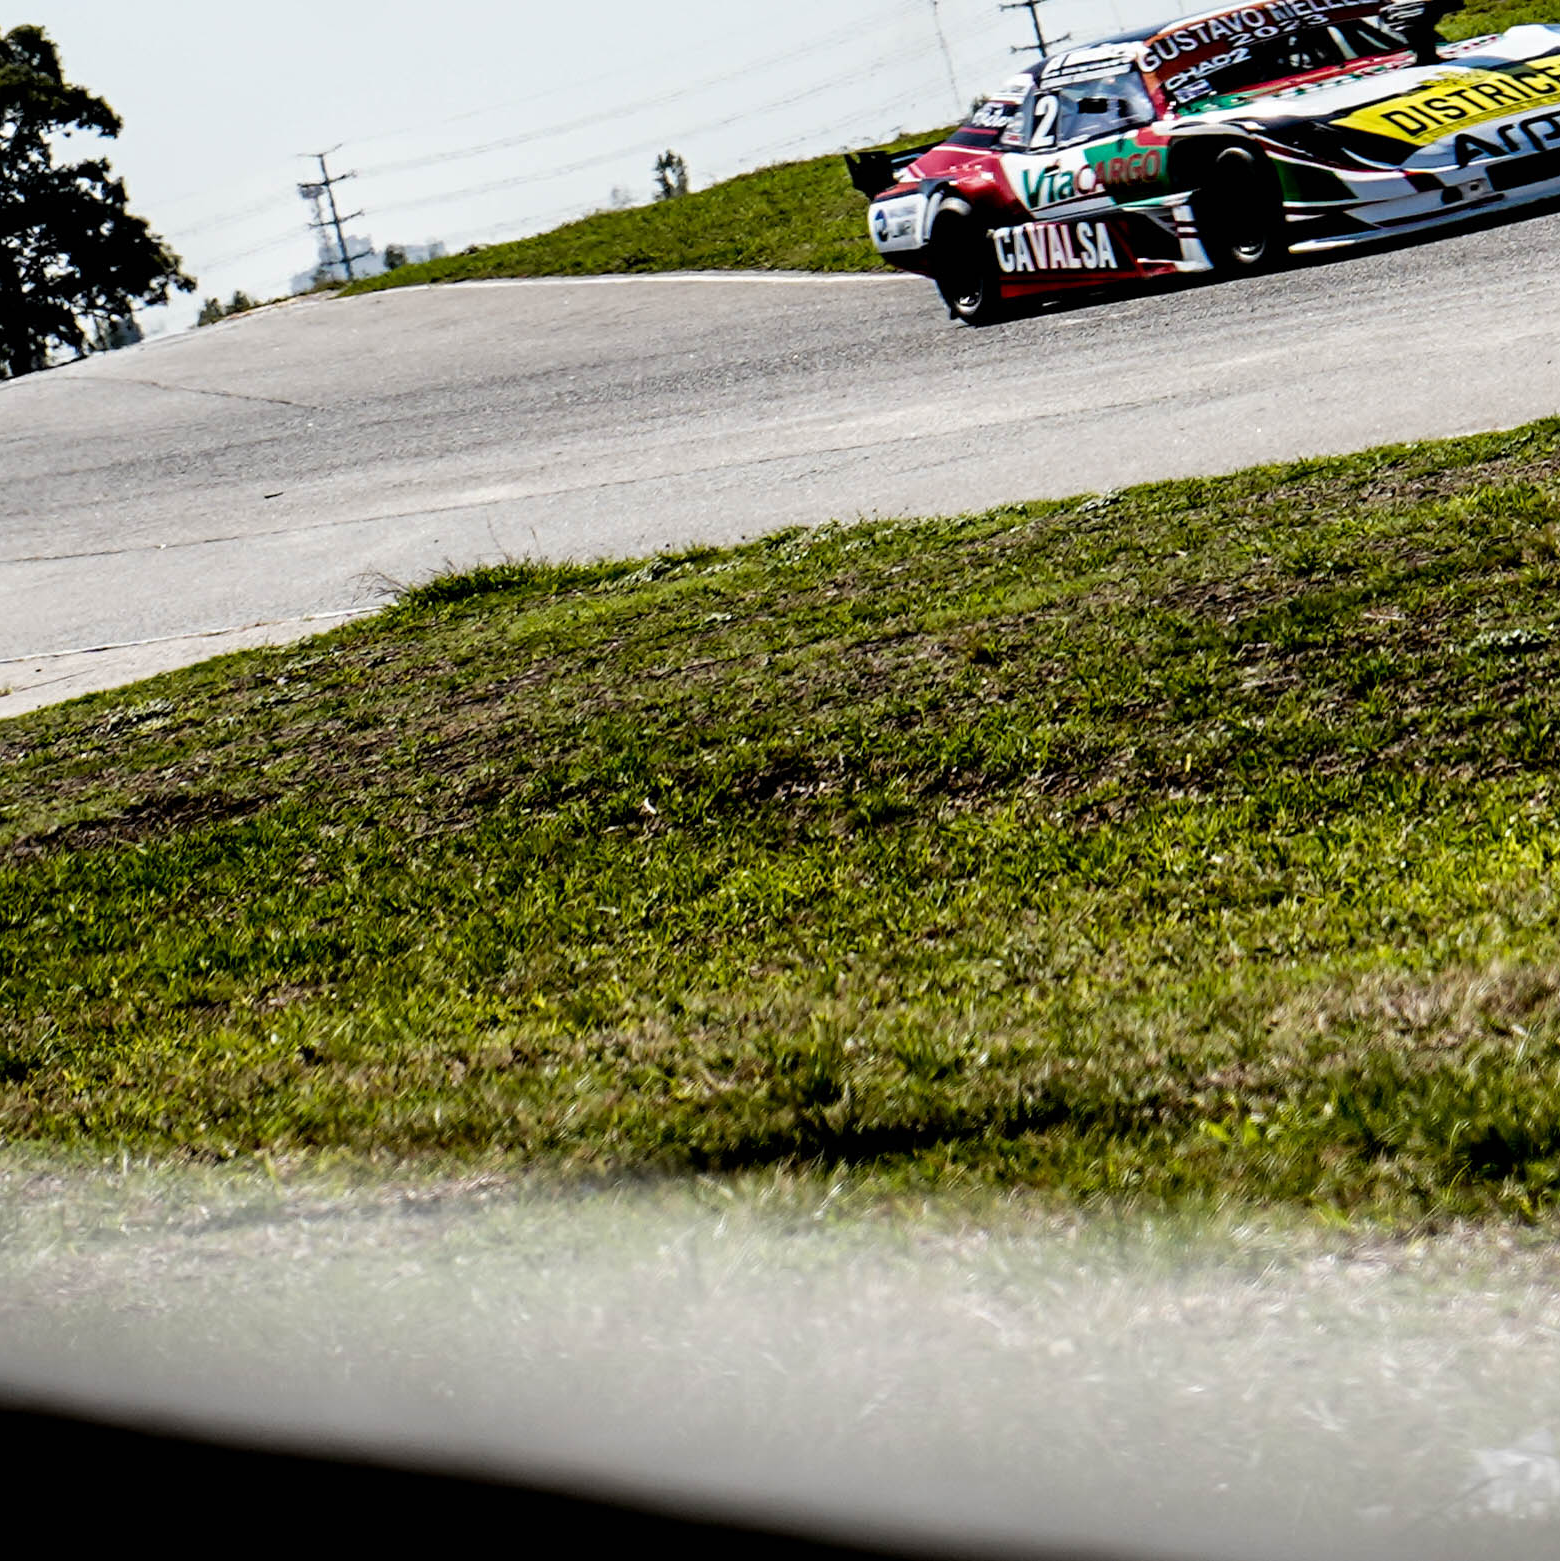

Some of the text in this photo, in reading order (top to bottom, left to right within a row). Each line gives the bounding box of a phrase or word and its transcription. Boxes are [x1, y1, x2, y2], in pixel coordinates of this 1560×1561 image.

[1138, 8, 1265, 73] GUSTAVO
[1229, 14, 1329, 47] 2023
[1030, 94, 1059, 148] 2
[993, 222, 1118, 273] CAVALSA
